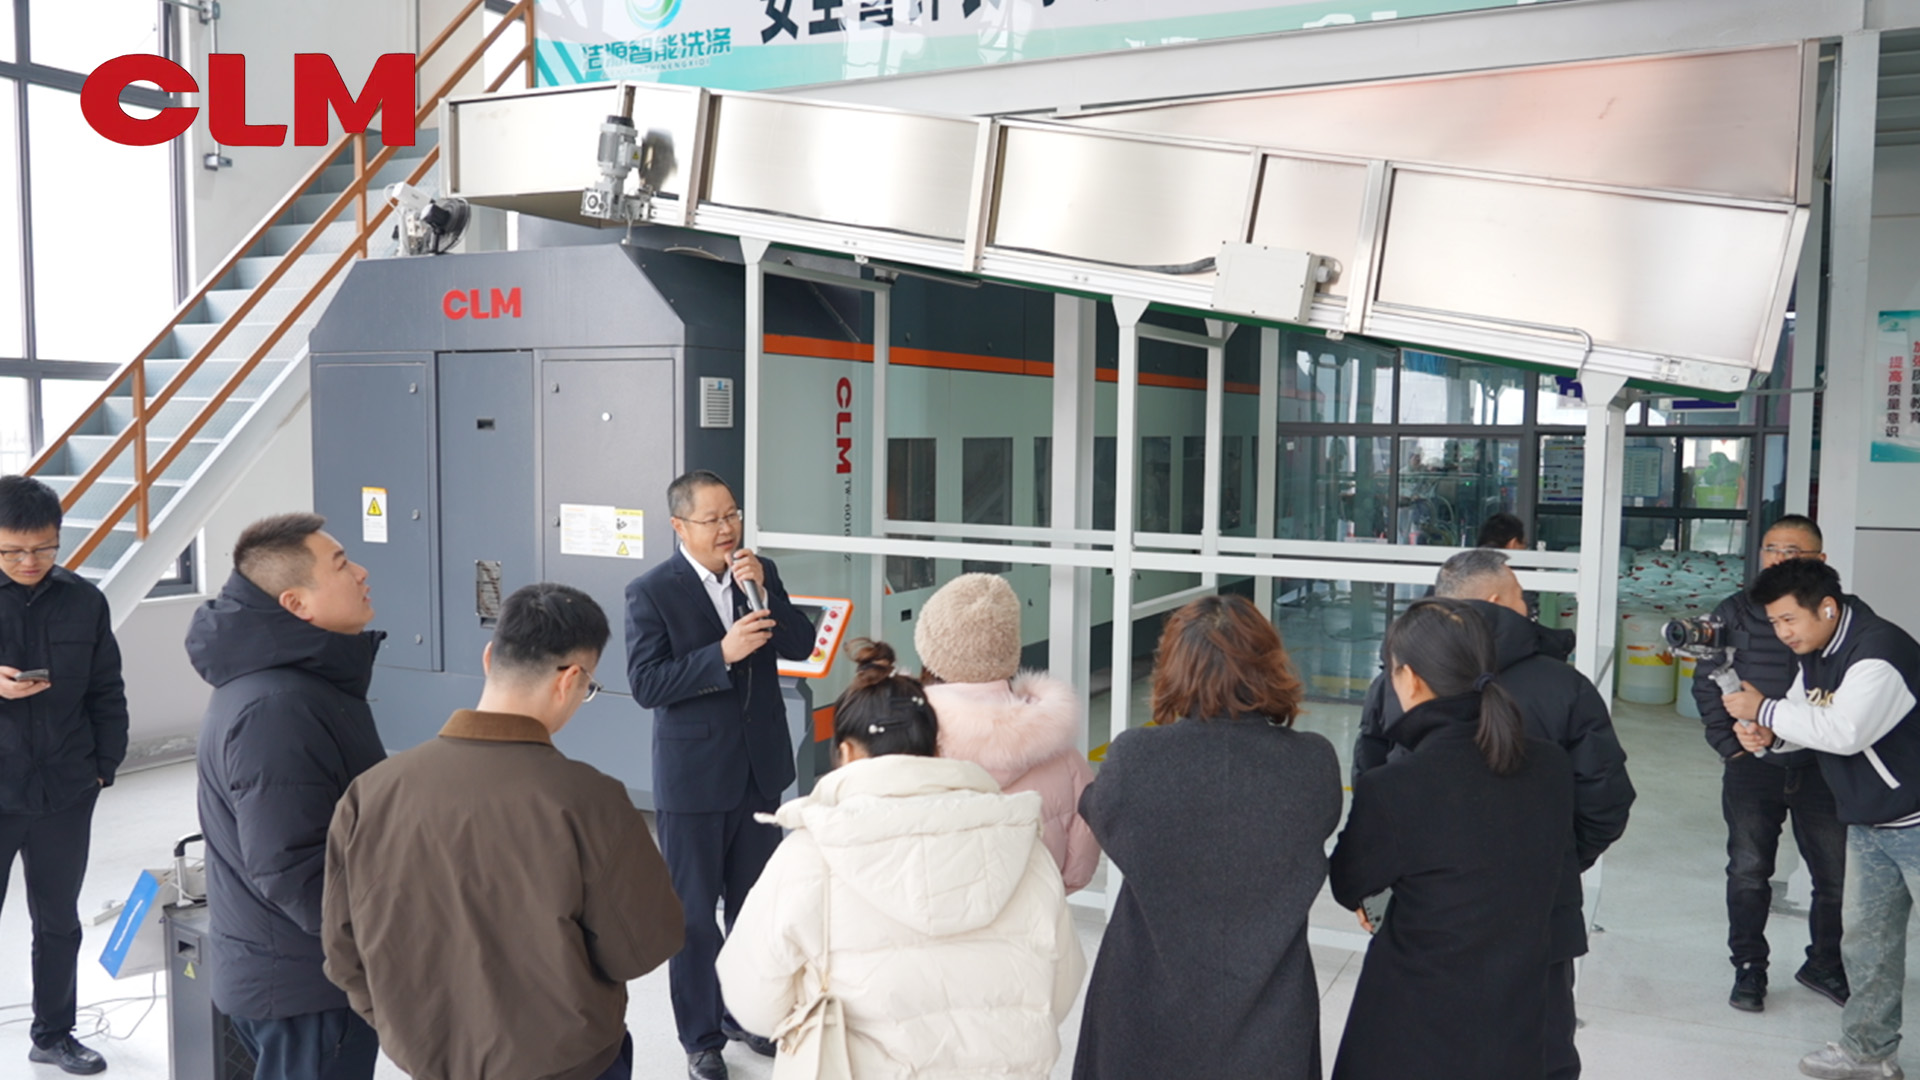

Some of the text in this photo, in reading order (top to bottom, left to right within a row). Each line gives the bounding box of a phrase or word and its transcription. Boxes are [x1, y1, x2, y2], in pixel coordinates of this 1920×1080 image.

[582, 27, 731, 70] 洁源智能洗涤
[443, 287, 522, 320] CLM
[836, 376, 852, 474] CLM
[1885, 356, 1904, 438] 提高质量意识
